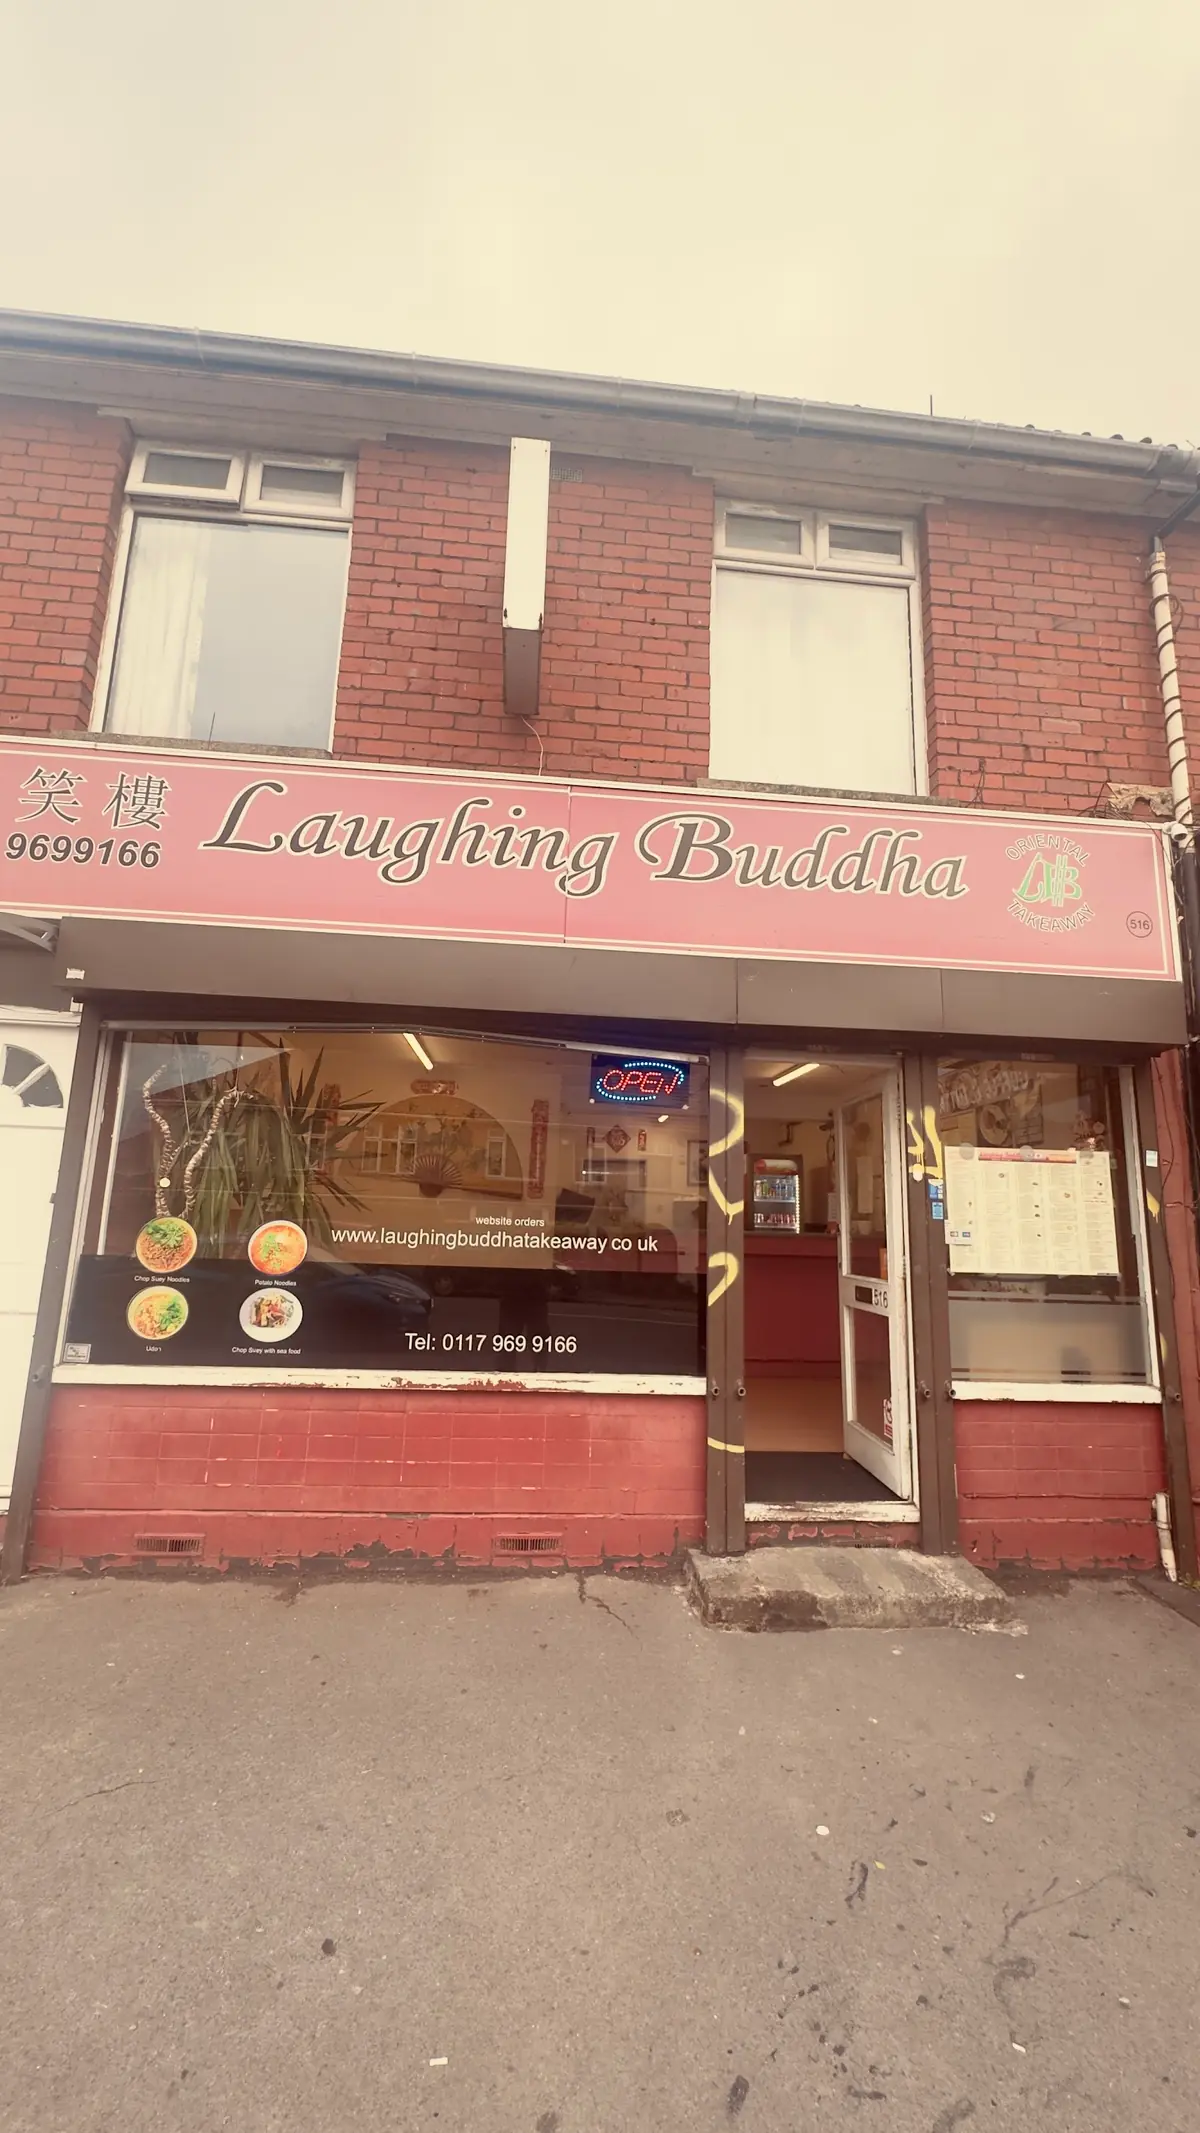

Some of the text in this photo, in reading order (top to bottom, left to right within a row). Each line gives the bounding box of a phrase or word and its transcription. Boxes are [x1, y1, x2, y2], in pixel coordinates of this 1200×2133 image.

[4, 831, 162, 869] 9699166
[197, 779, 970, 900] Laughing Buddha
[1005, 833, 1090, 868] ORIENTAL
[1006, 898, 1096, 933] TAKEAWAY
[1129, 918, 1151, 931] 516
[602, 1069, 679, 1095] OPEN
[475, 1215, 545, 1228] website orders
[873, 1289, 888, 1309] 516
[405, 1332, 578, 1354] Tel: 0117 969 9166
